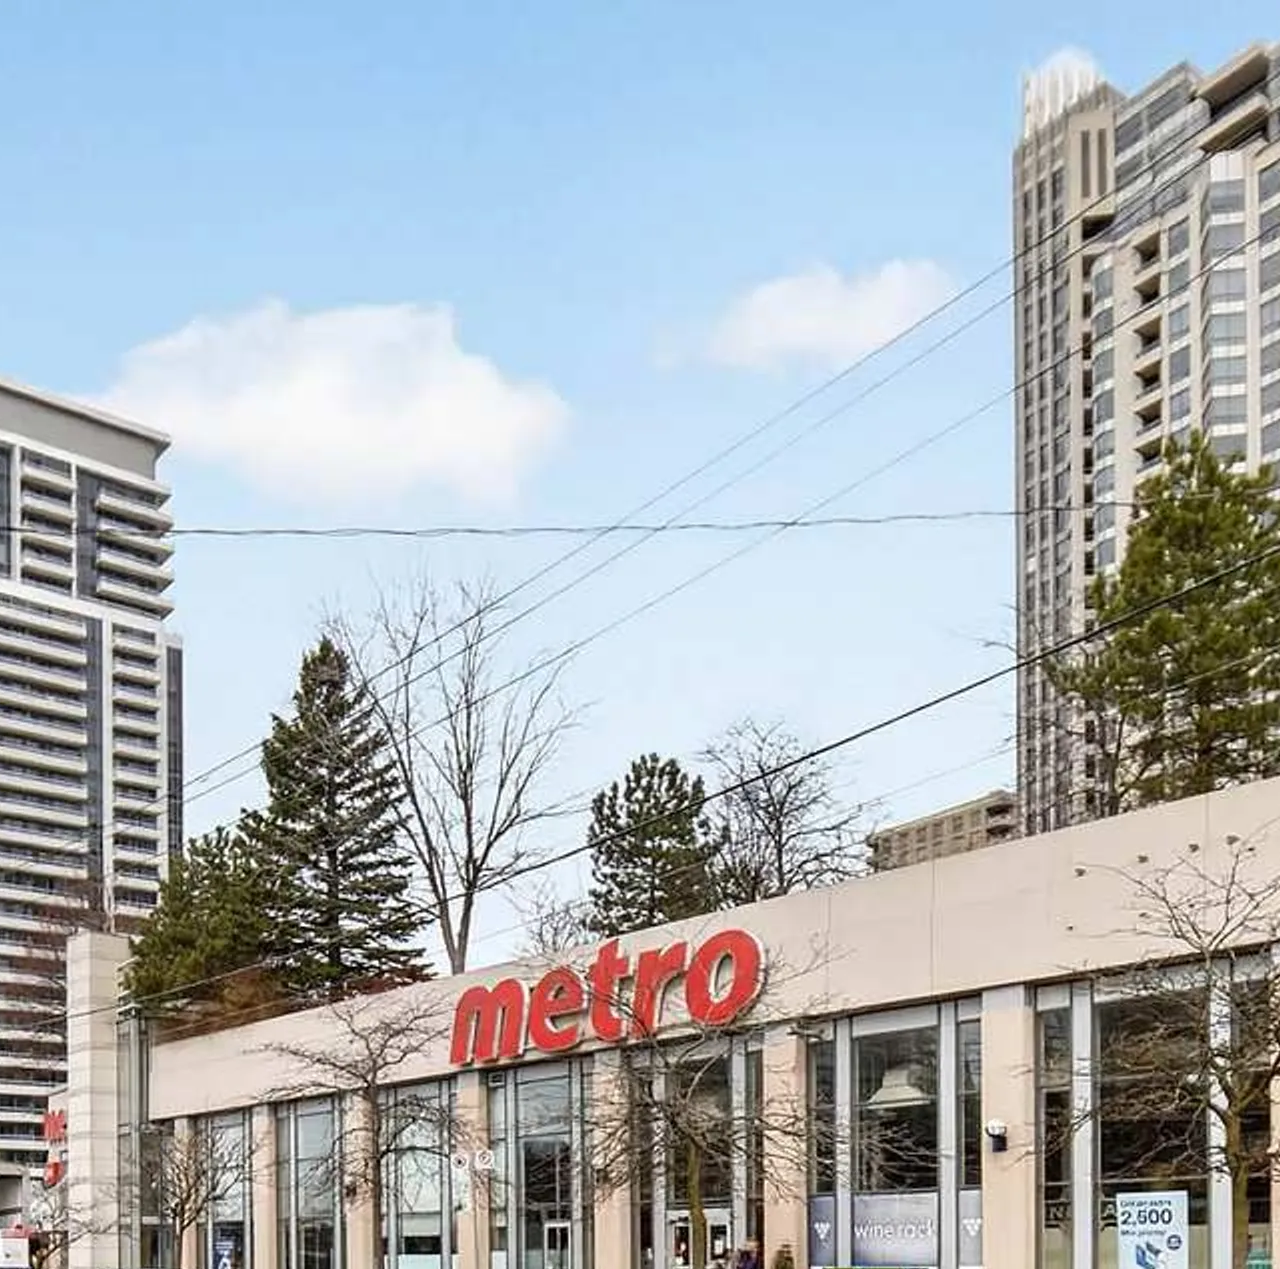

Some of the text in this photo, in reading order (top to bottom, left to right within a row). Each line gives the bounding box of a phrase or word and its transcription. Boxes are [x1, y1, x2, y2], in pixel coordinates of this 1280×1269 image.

[449, 928, 767, 1067] metro
[854, 1218, 937, 1239] wine rack
